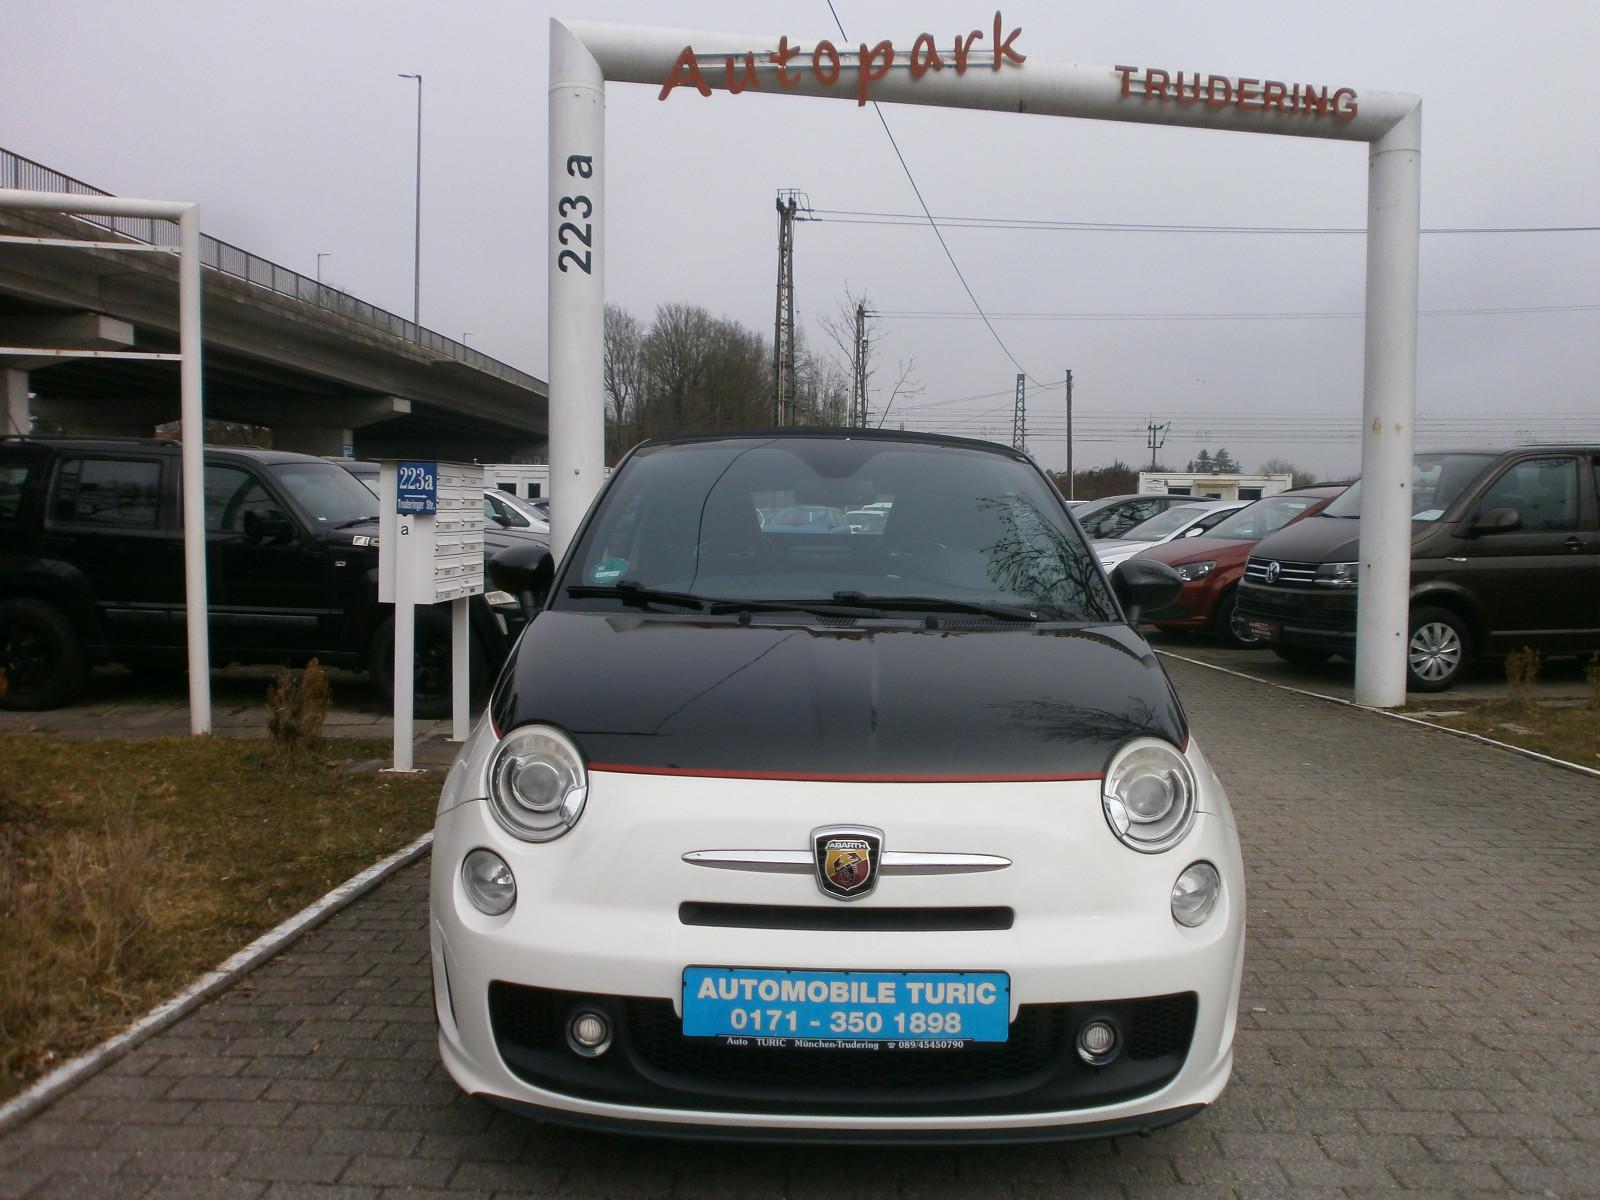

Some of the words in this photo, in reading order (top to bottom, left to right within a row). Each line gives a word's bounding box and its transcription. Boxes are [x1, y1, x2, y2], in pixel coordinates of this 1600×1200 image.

[658, 10, 1026, 107] Autopark
[1114, 64, 1358, 121] TRUDERING
[566, 154, 593, 179] a
[558, 195, 593, 275] 223
[400, 467, 433, 490] 223a
[401, 525, 409, 535] a
[697, 977, 897, 1004] AUTOMOBILE
[906, 982, 996, 1005] TURIC
[730, 1008, 797, 1032] 0171
[830, 1011, 883, 1034] 350
[894, 1012, 961, 1034] 1898
[726, 1036, 749, 1046] Auto
[755, 1038, 787, 1047] TURIC
[794, 1039, 880, 1051] München-Trudering
[898, 1040, 964, 1050] 089/45450790
